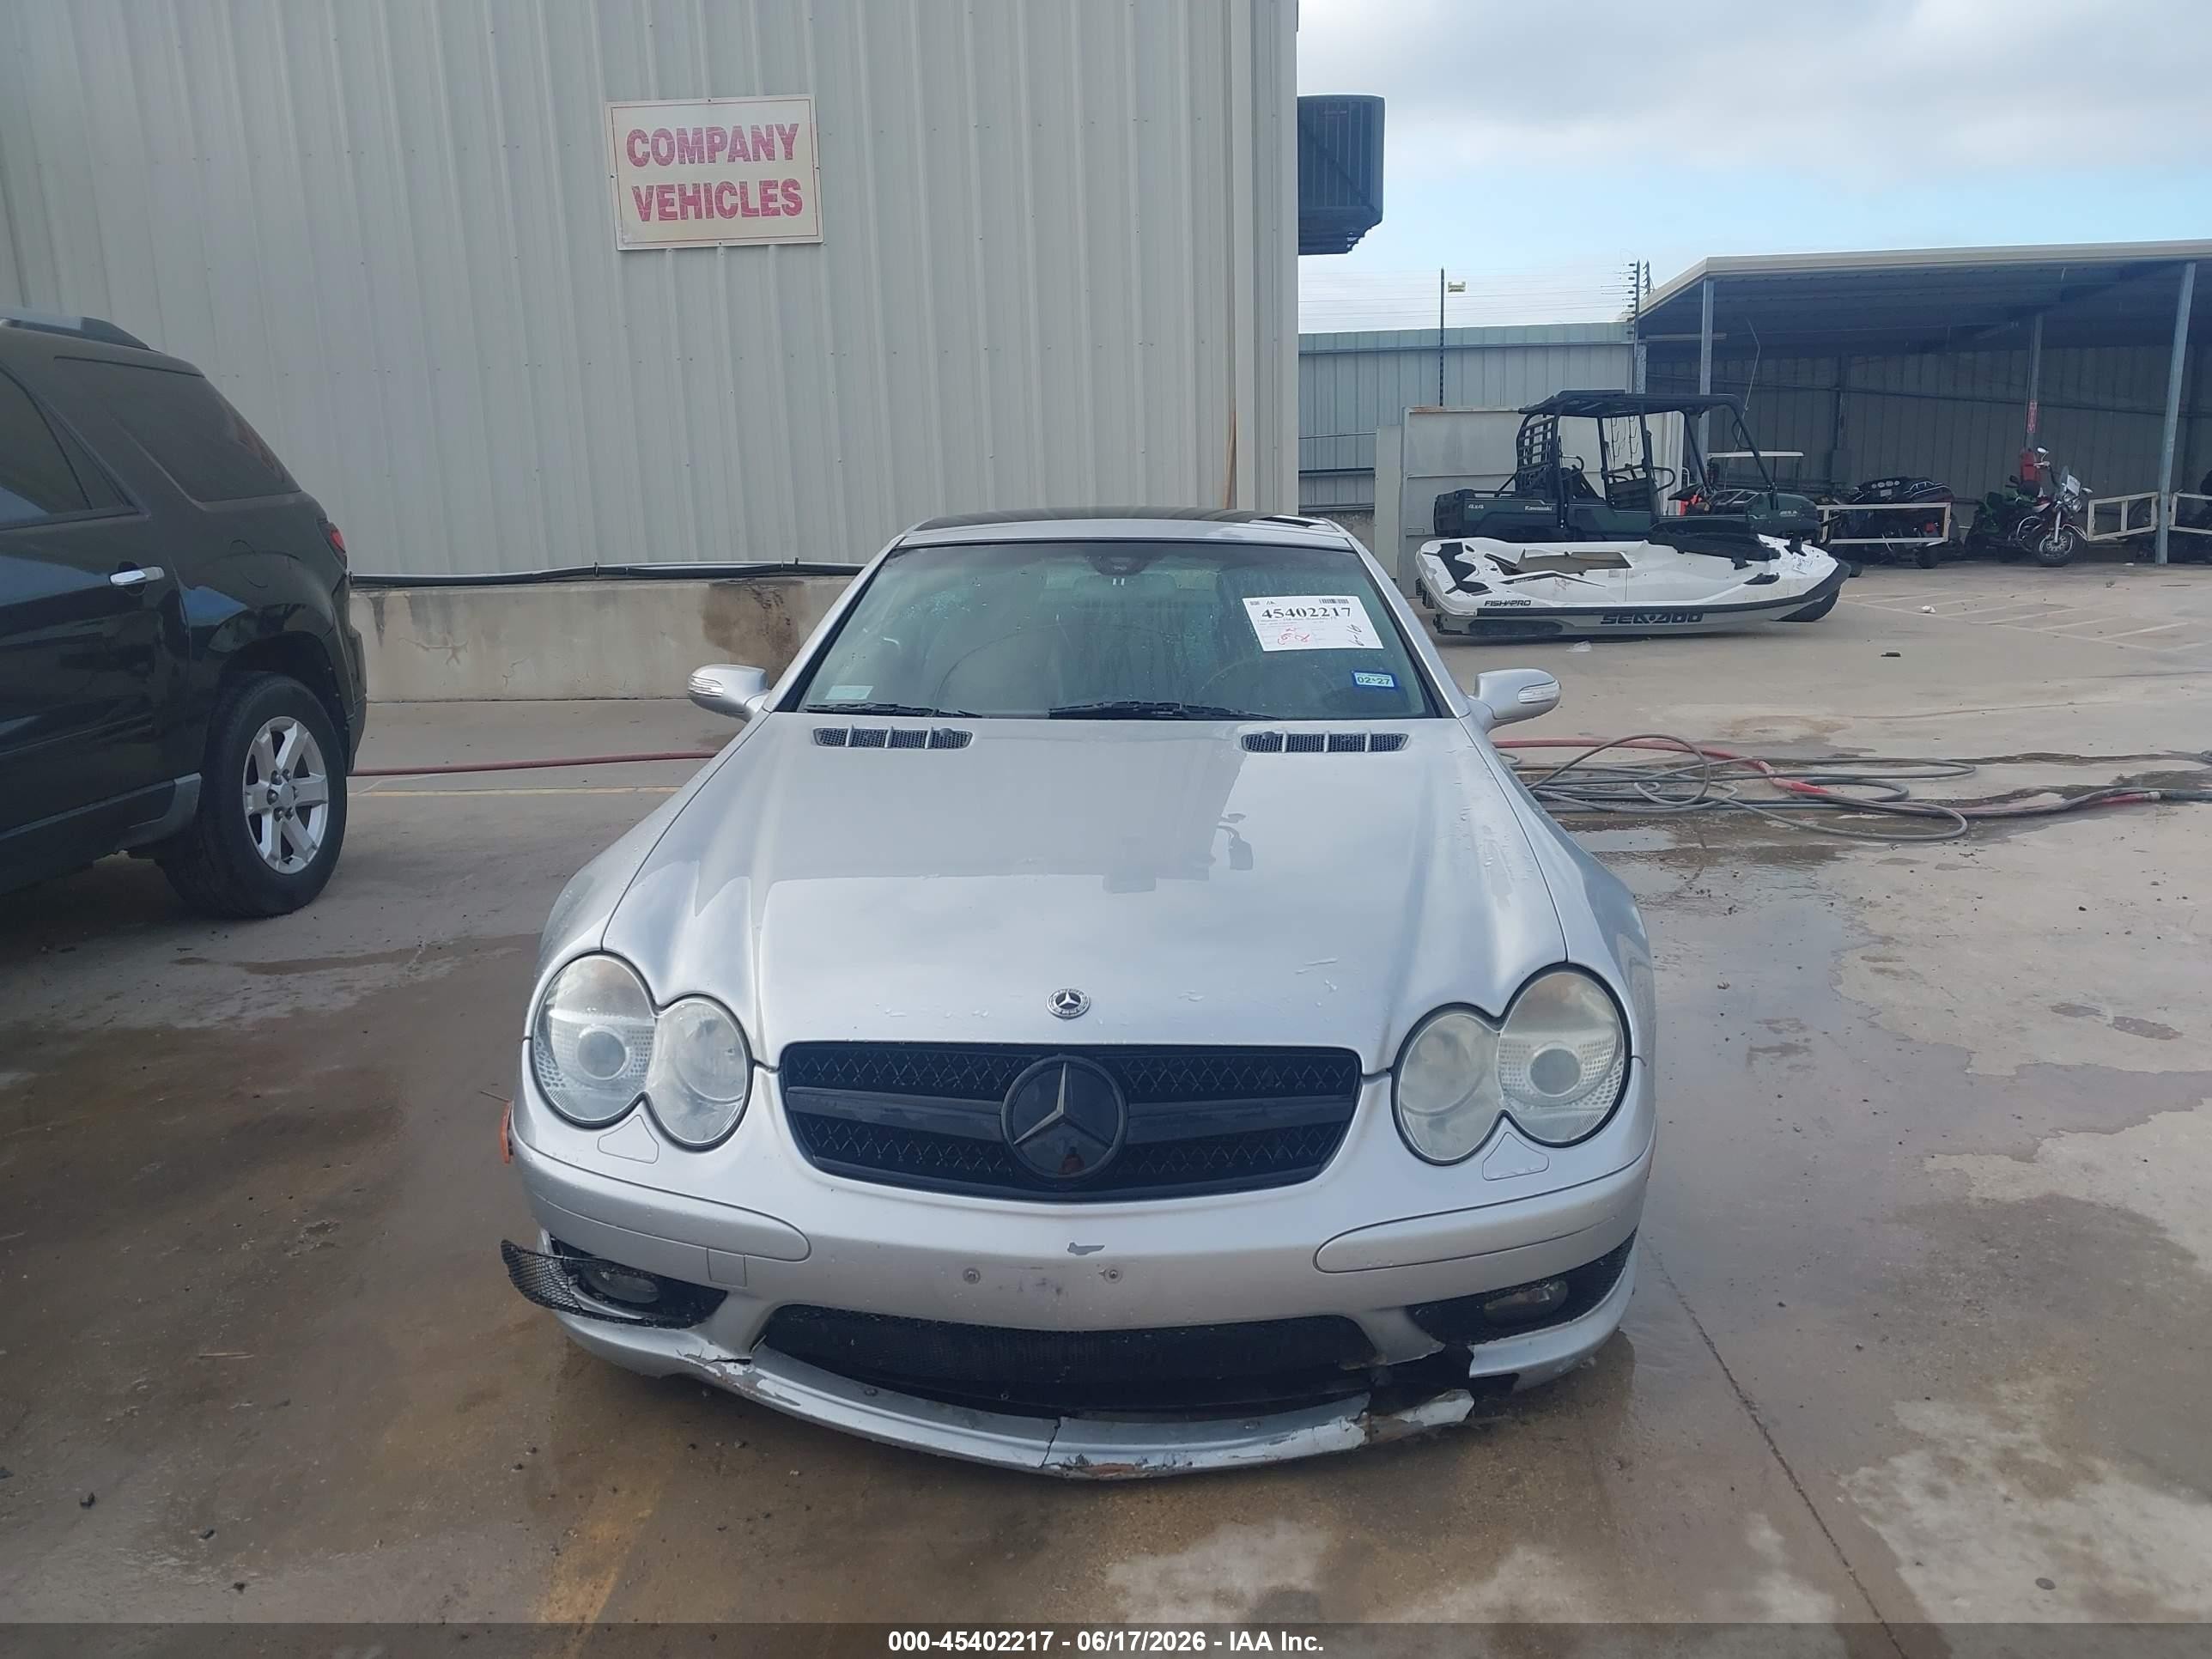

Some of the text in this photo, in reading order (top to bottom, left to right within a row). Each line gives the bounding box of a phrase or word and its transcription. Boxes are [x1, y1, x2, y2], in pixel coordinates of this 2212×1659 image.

[626, 123, 799, 167] COMPANY
[631, 178, 804, 222] VEHICLES
[1261, 606, 1351, 619] 45402217
